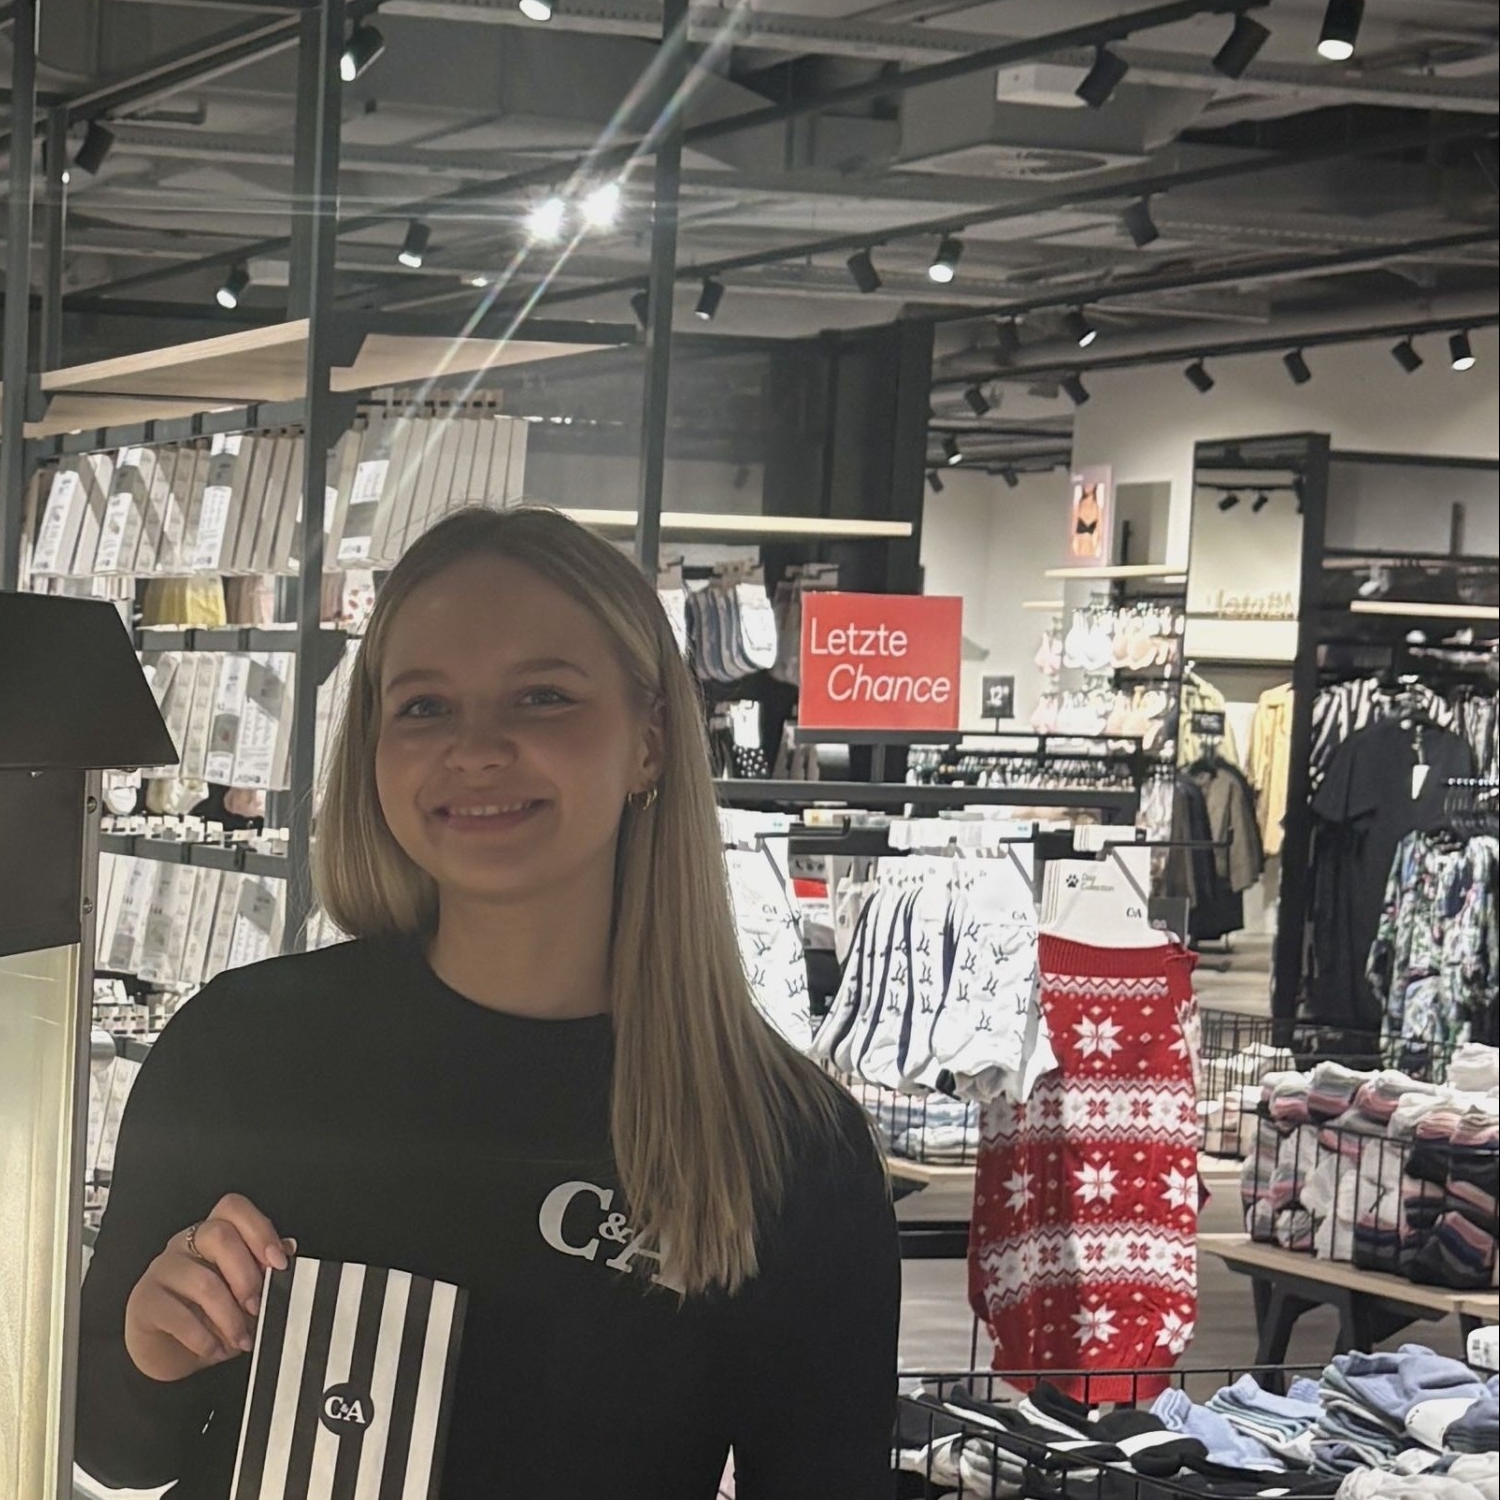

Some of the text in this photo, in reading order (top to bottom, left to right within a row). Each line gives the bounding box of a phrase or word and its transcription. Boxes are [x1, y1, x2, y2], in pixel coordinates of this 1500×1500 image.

[811, 617, 907, 657] Letzte
[827, 663, 950, 703] Chance
[539, 1180, 686, 1294] C&A
[324, 1396, 366, 1424] C&A
